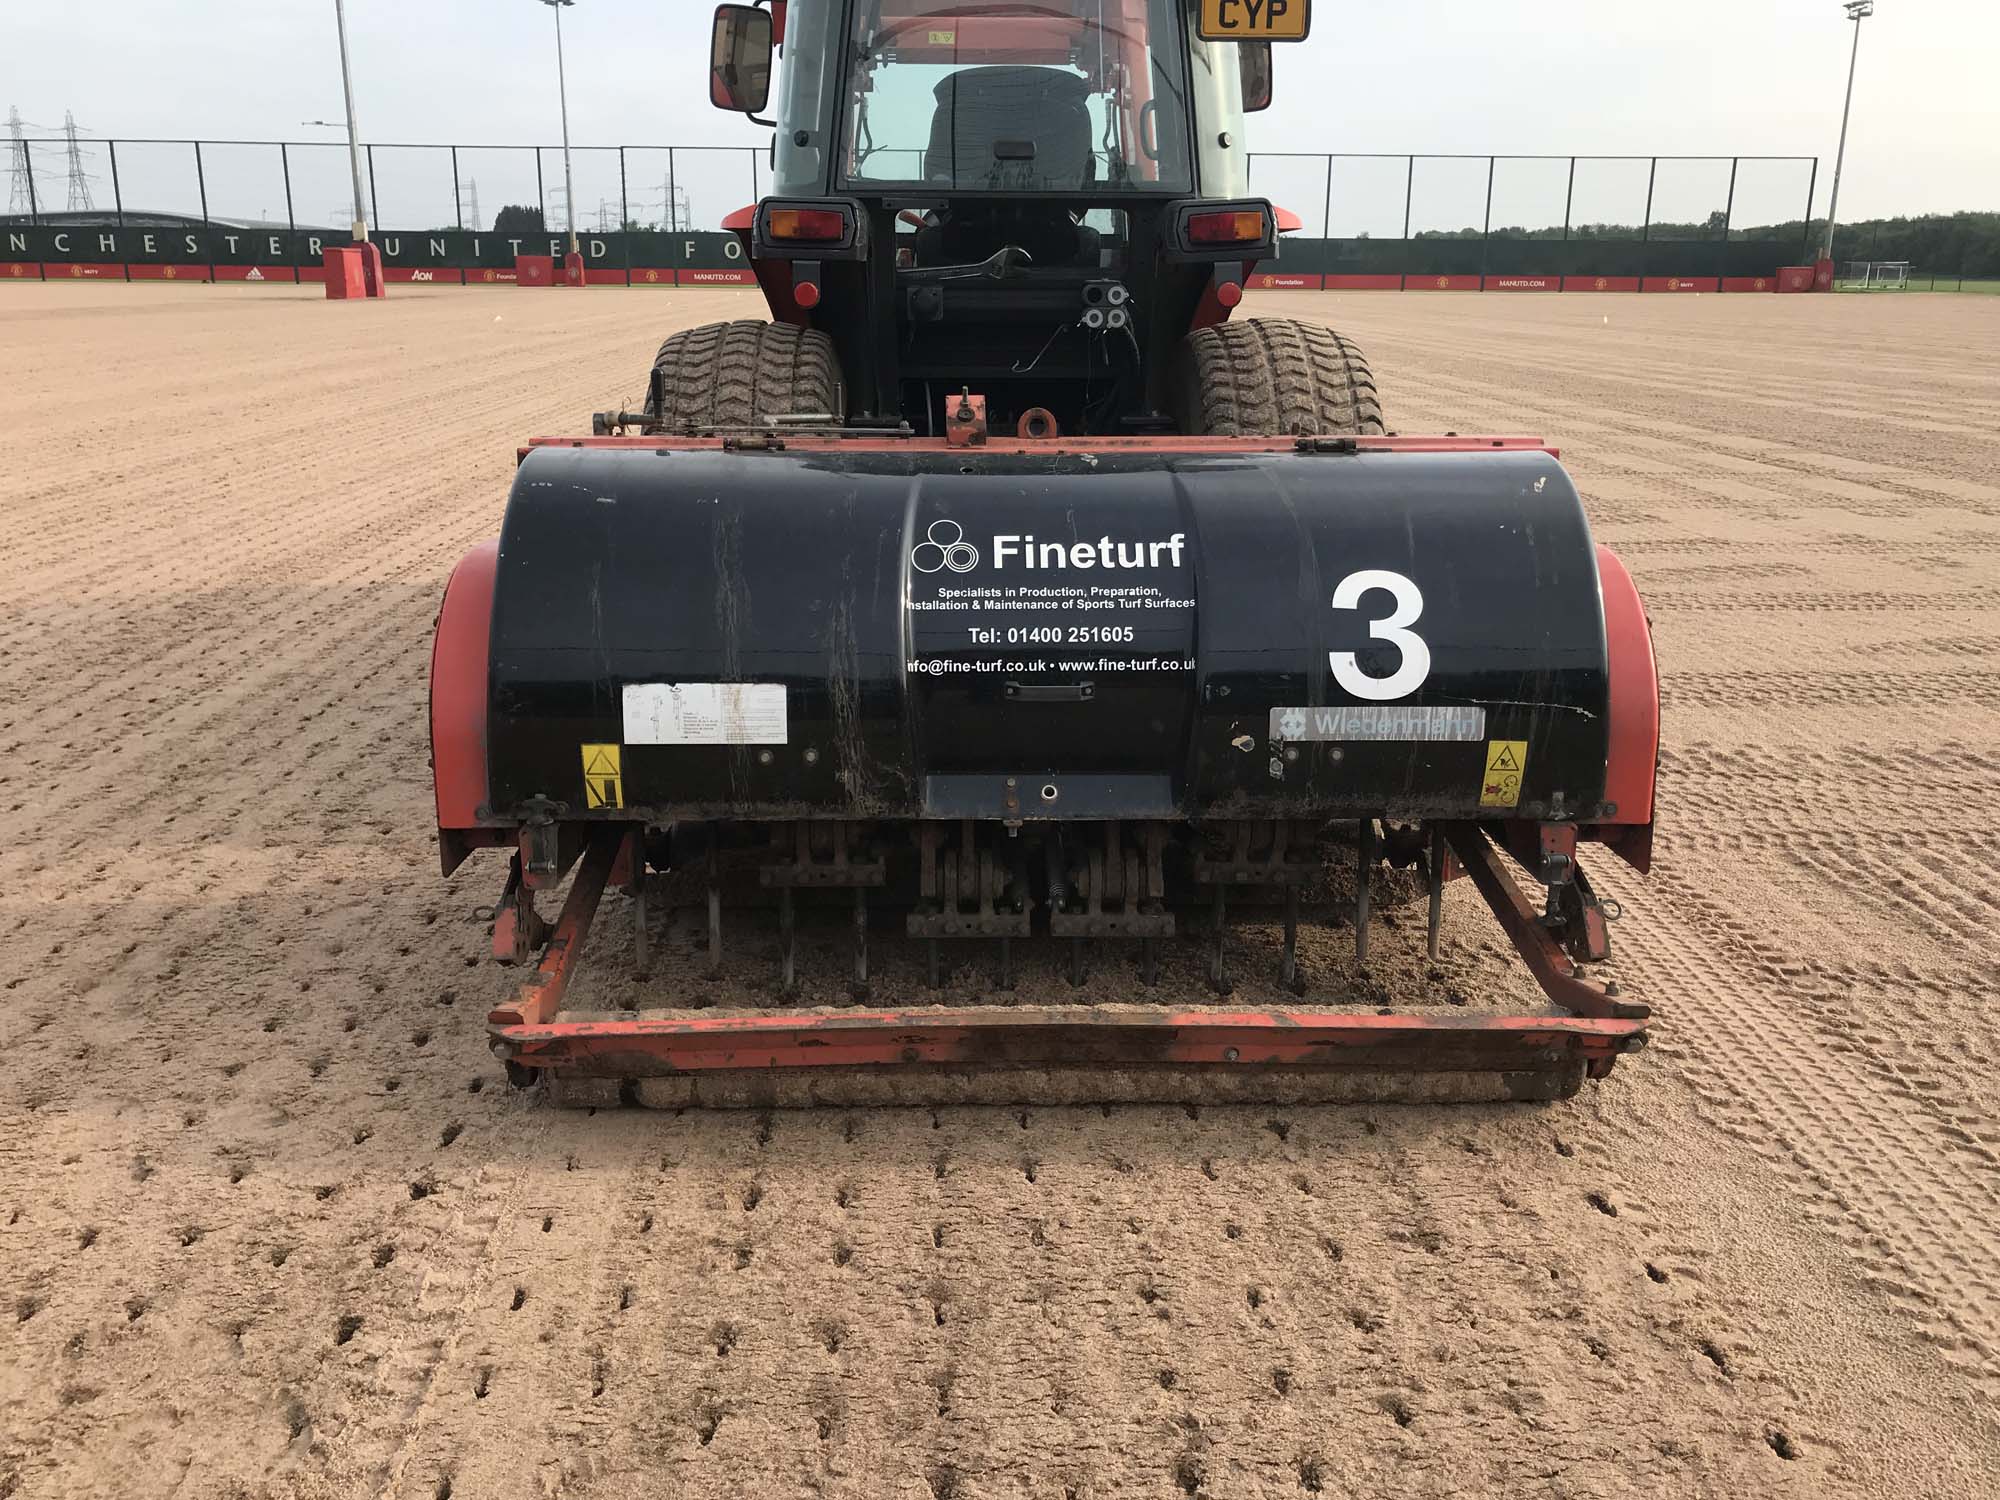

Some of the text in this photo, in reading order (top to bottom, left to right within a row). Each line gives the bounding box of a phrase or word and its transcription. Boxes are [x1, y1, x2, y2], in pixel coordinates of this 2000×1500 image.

[1219, 0, 1287, 29] CYP
[385, 238, 606, 258] UNITED
[694, 273, 742, 281] MANUTD.COM
[1275, 278, 1304, 286] Foundation
[1499, 279, 1545, 288] MANUTD.COM
[993, 533, 1185, 569] Fineturf
[938, 586, 1162, 599] Specialists in Production, Preparation,
[972, 600, 981, 610] &
[984, 599, 1058, 610] Maintenance
[1061, 599, 1074, 609] of
[1076, 599, 1115, 611] Sports
[1117, 598, 1142, 609] Turf
[1144, 598, 1196, 609] Surfaces
[968, 626, 1134, 643] Tel: 01400 251605
[1329, 569, 1431, 700] 3
[1058, 657, 1196, 671] www.fine-turf.co.uk
